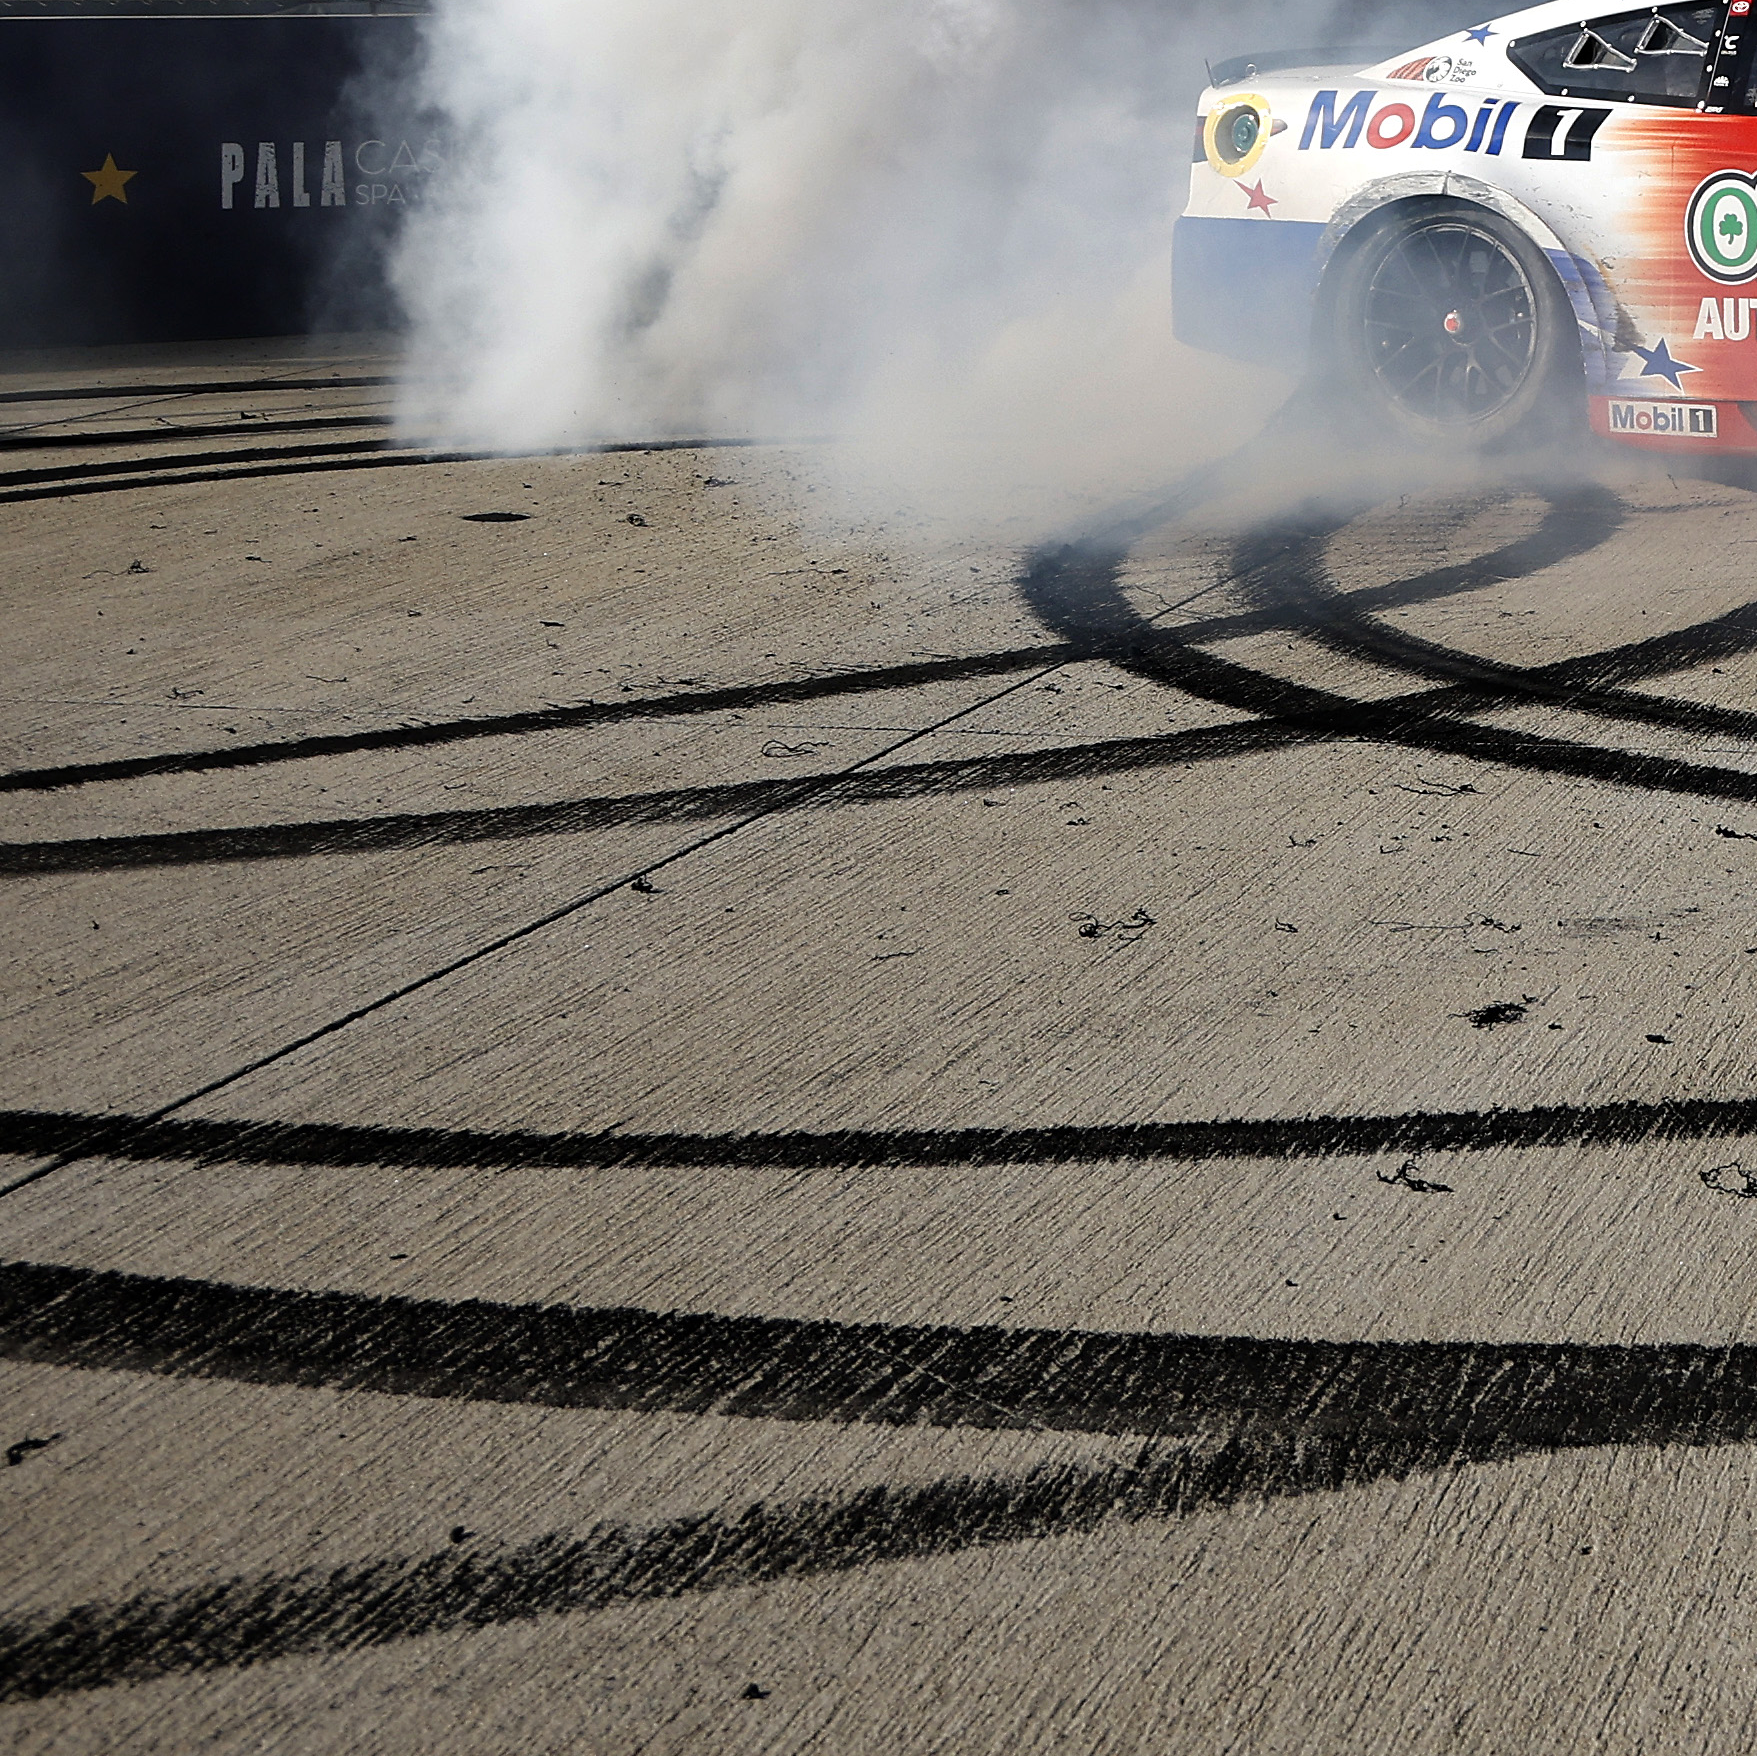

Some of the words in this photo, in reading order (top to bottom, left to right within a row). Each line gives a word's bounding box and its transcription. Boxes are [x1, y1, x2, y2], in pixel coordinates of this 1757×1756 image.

[1452, 66, 1477, 76] Diego
[1457, 58, 1473, 67] San
[1449, 74, 1466, 83] Zoo
[1298, 90, 1522, 156] Mobil
[221, 140, 347, 209] PALA
[1612, 404, 1684, 432] Mobil
